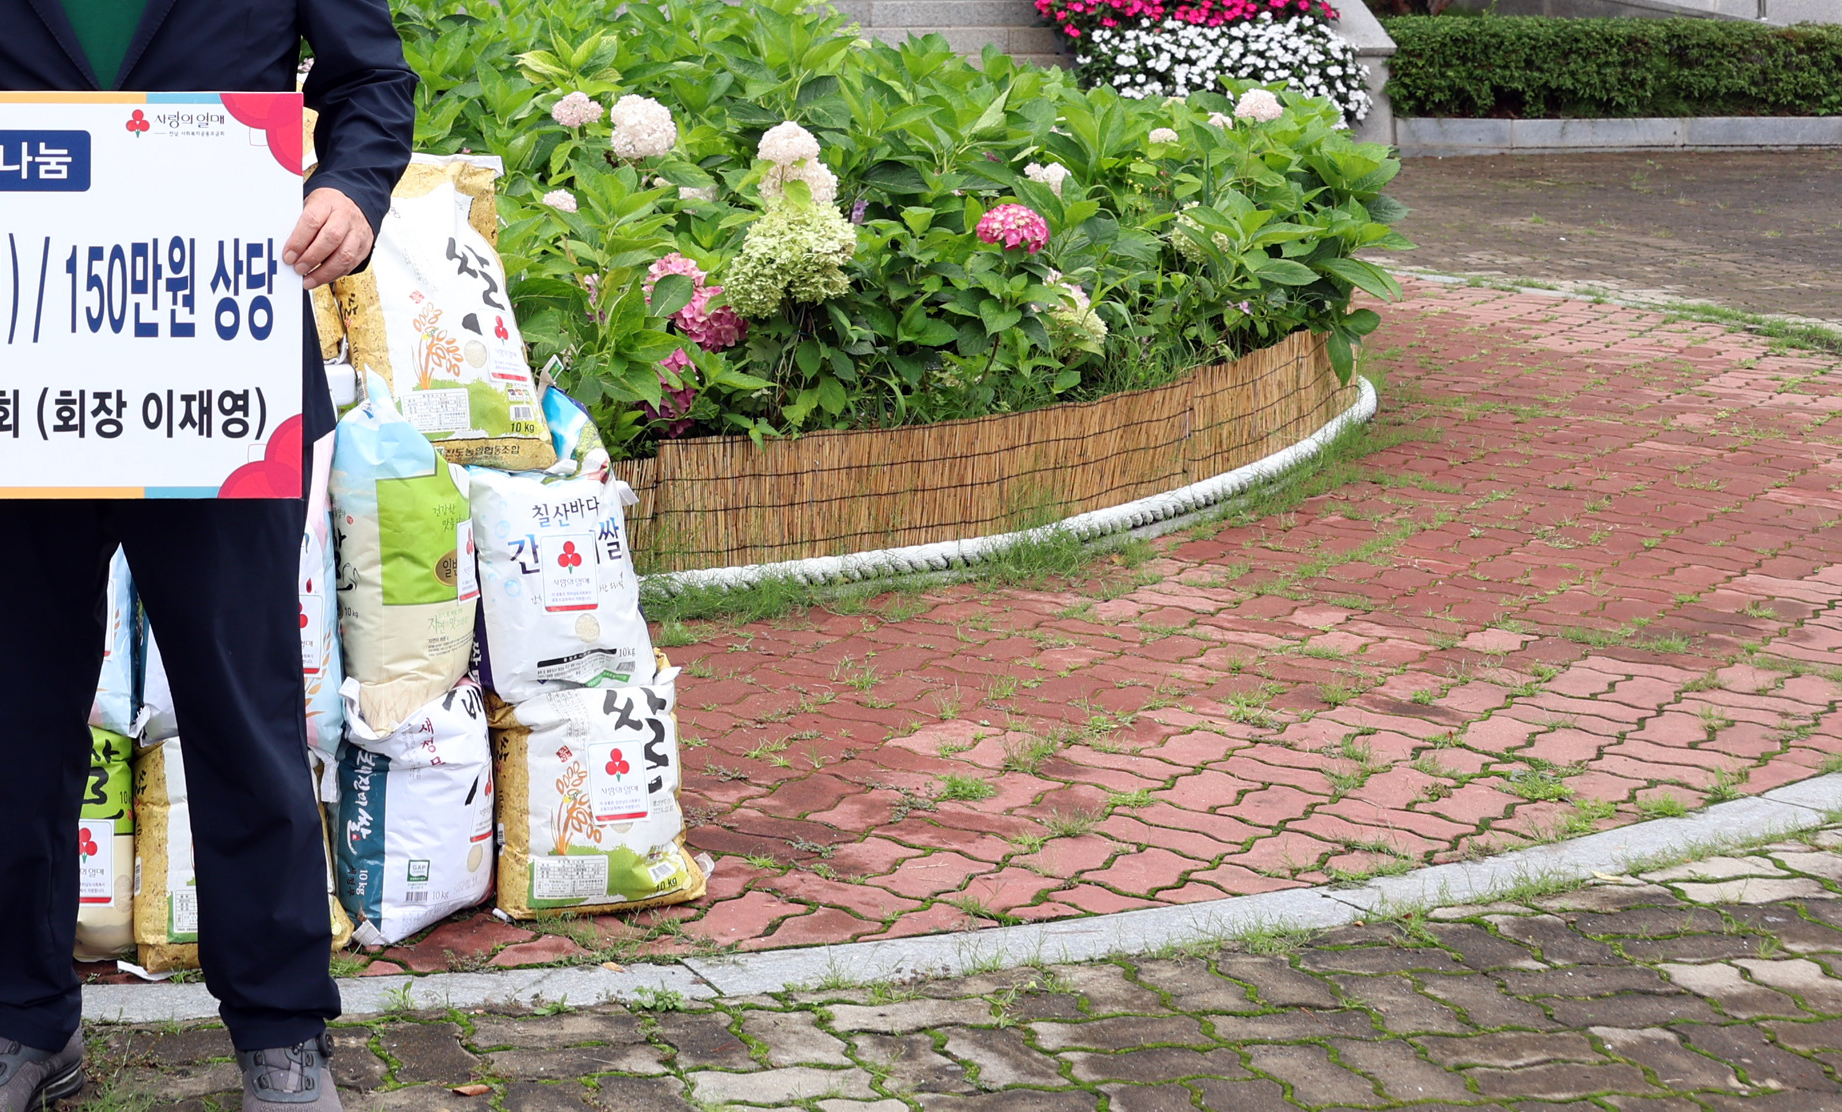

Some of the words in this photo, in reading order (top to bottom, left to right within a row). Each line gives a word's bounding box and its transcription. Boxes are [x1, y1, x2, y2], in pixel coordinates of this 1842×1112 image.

[33, 237, 50, 342] /
[66, 236, 195, 337] 150만원
[210, 238, 277, 340] 상당
[37, 387, 127, 440] (회장
[142, 387, 267, 440] 이재영)
[510, 423, 521, 432] 10
[524, 423, 535, 433] kg
[532, 496, 600, 528] 칠산바다
[508, 517, 622, 575] 간쌀
[345, 607, 351, 616] 10
[79, 867, 105, 877] 의열매
[359, 870, 368, 880] 10
[356, 882, 367, 896] kg
[432, 891, 440, 899] 10
[441, 890, 449, 899] kg
